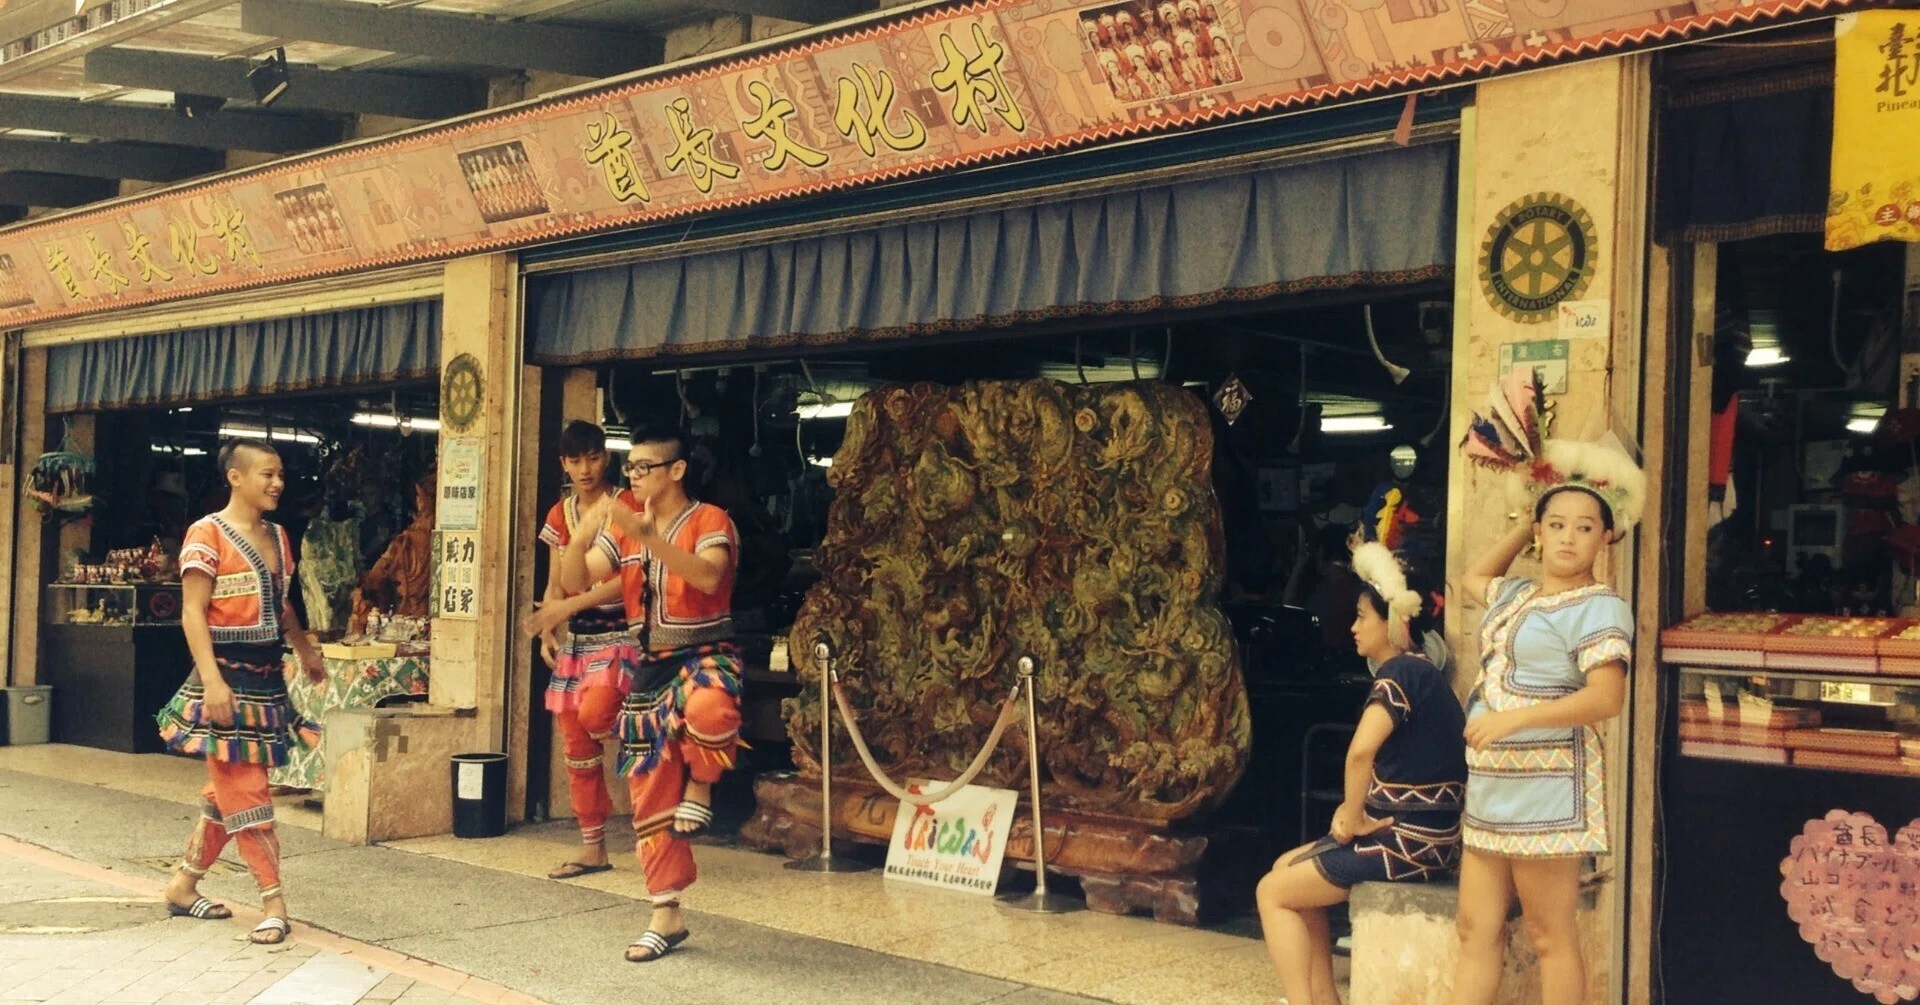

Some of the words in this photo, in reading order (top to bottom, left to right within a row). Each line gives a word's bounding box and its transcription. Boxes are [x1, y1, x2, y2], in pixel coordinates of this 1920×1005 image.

[584, 22, 1025, 203] 酋長文化村
[1877, 99, 1920, 113] Pinea
[1517, 206, 1565, 224] ROTARY
[45, 198, 263, 298] 酋長文化村
[1494, 274, 1577, 312] INTERNATIONAL
[1220, 381, 1243, 414] 福
[906, 854, 930, 869] Touch
[934, 857, 953, 872] Your
[957, 861, 982, 876] Heart
